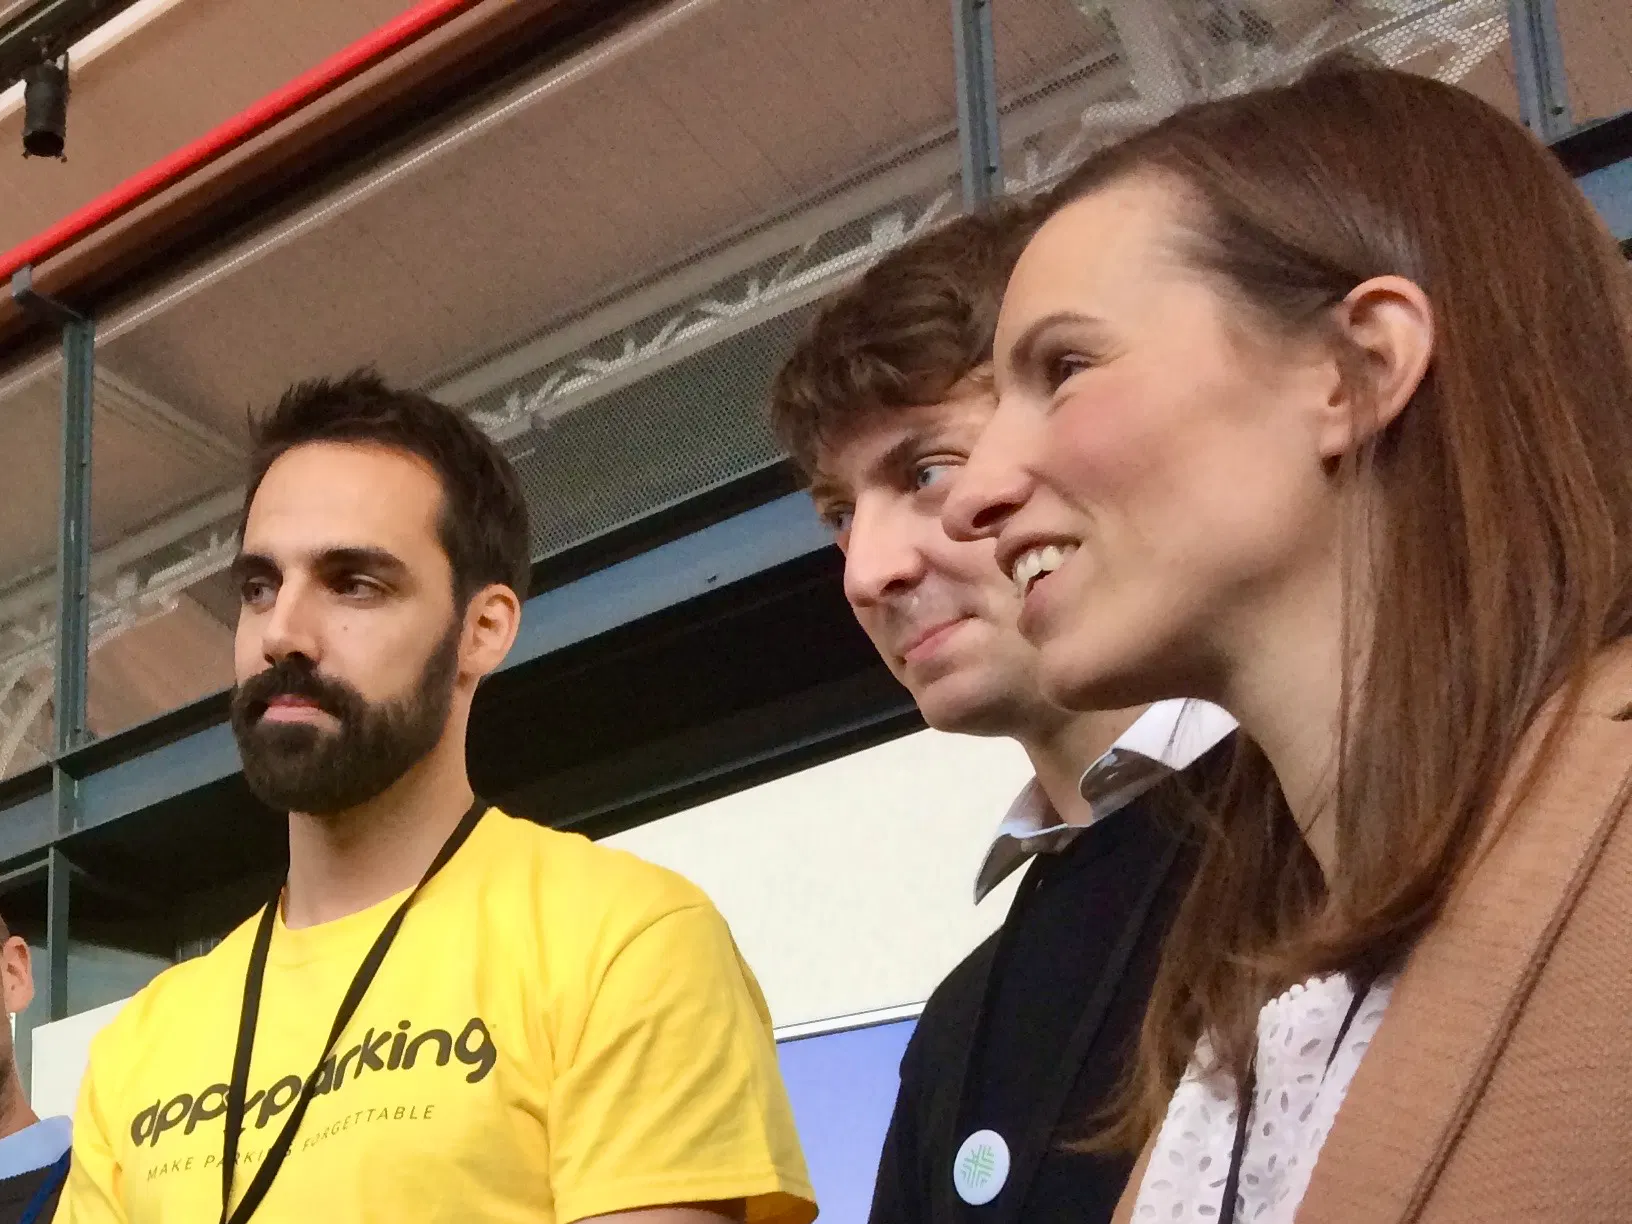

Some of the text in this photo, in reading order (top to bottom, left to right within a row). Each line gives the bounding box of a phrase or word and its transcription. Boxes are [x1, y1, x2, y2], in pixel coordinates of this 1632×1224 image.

[147, 1105, 435, 1181] MAKE PARKI FORGETTABLE
